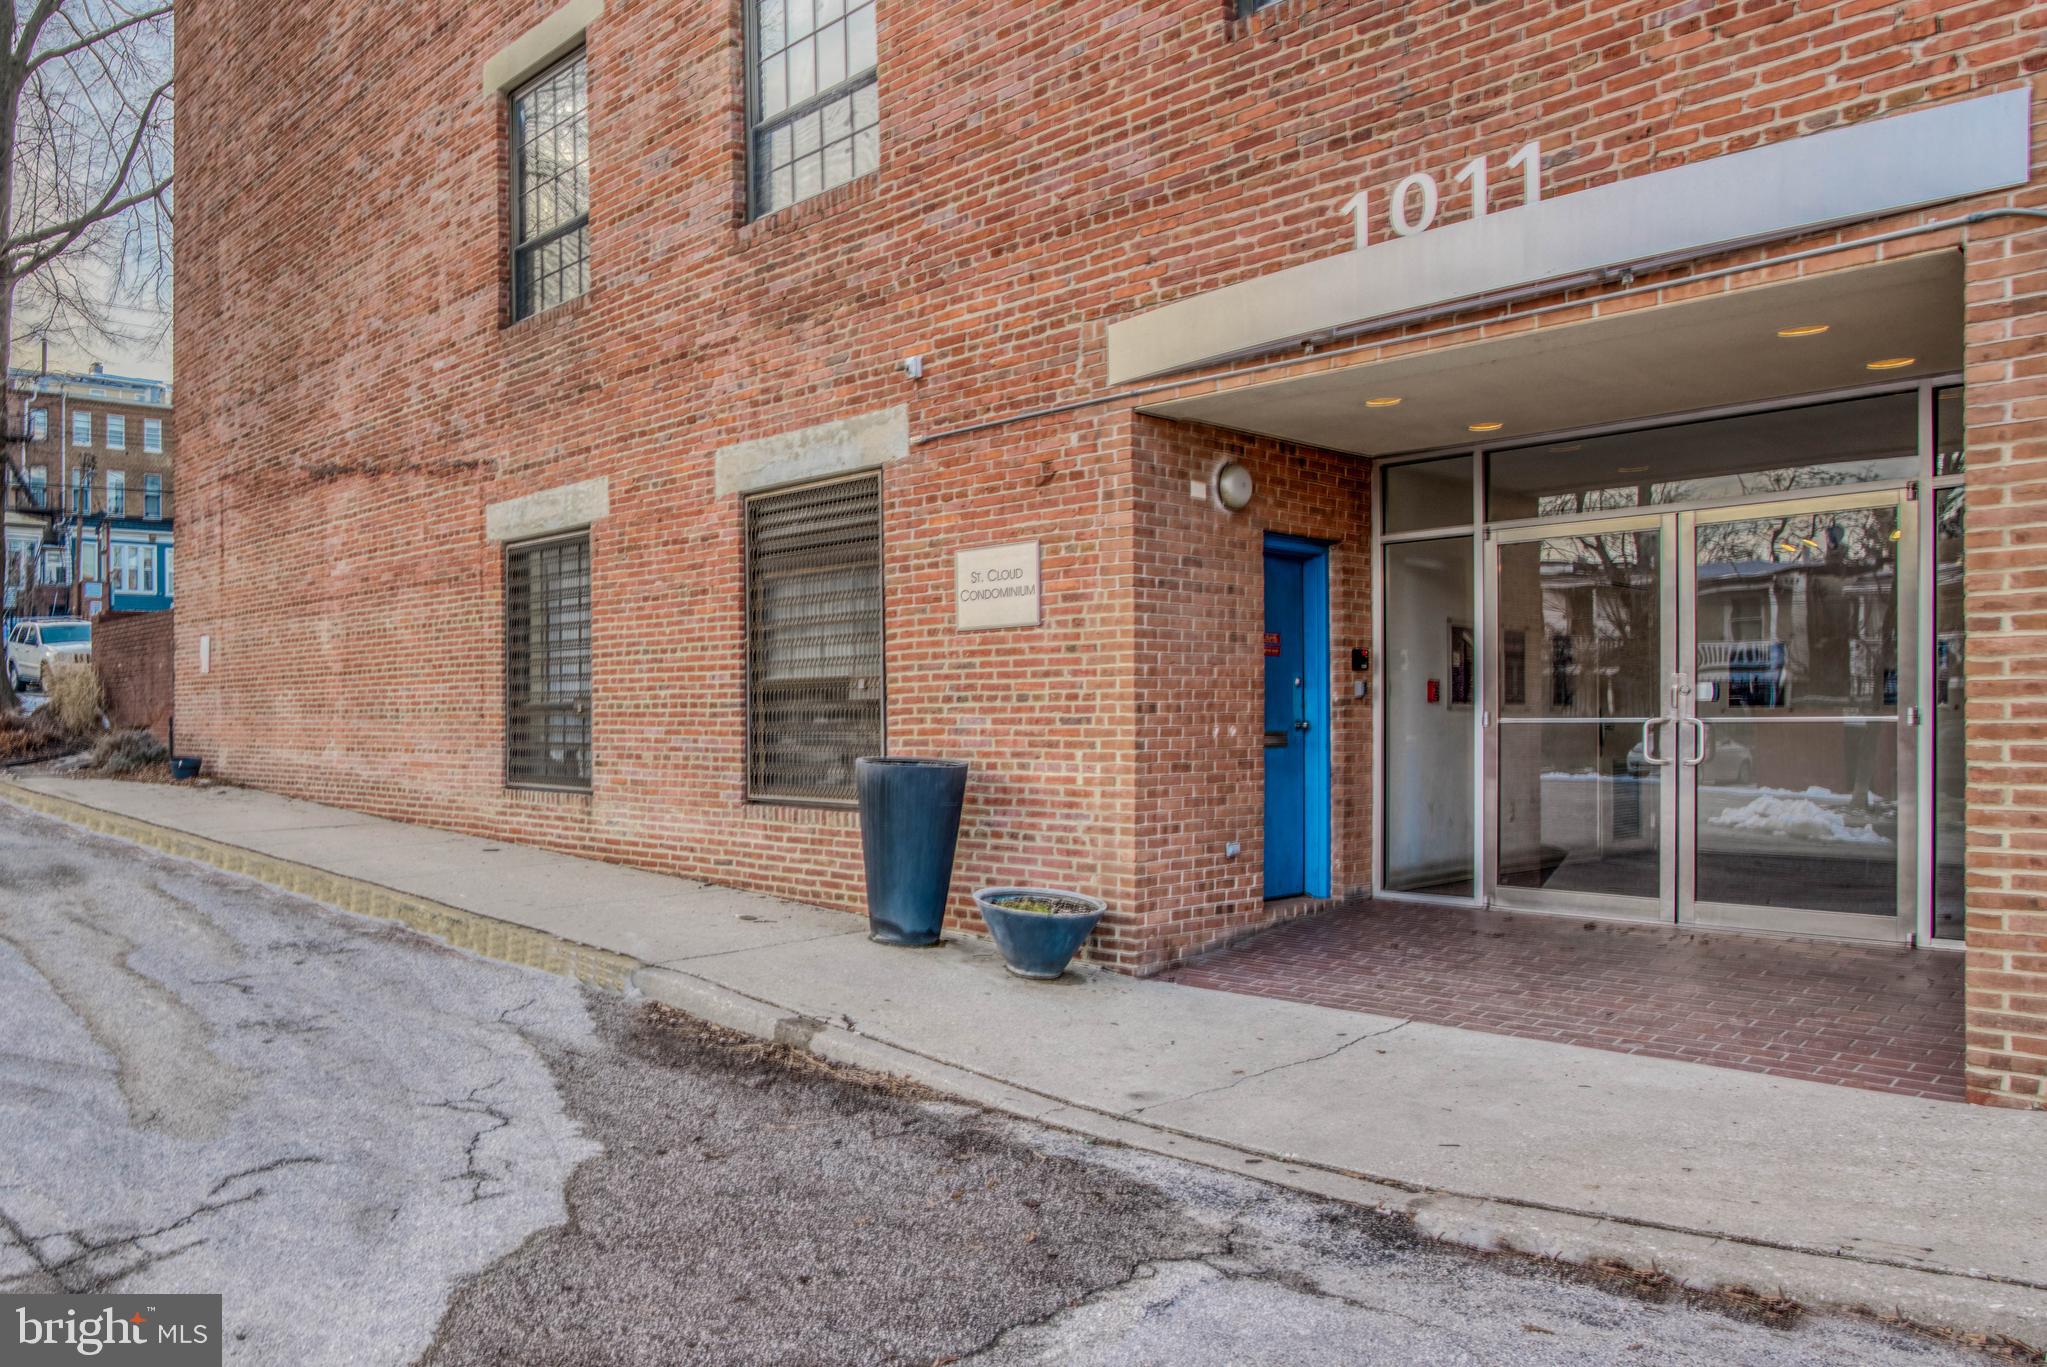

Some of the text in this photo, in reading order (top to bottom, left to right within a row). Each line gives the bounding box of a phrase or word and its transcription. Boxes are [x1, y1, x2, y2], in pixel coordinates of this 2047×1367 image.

[1340, 141, 1541, 249] 1011
[987, 568, 1024, 582] CLOUD
[960, 584, 1036, 602] CONDOMINIUM
